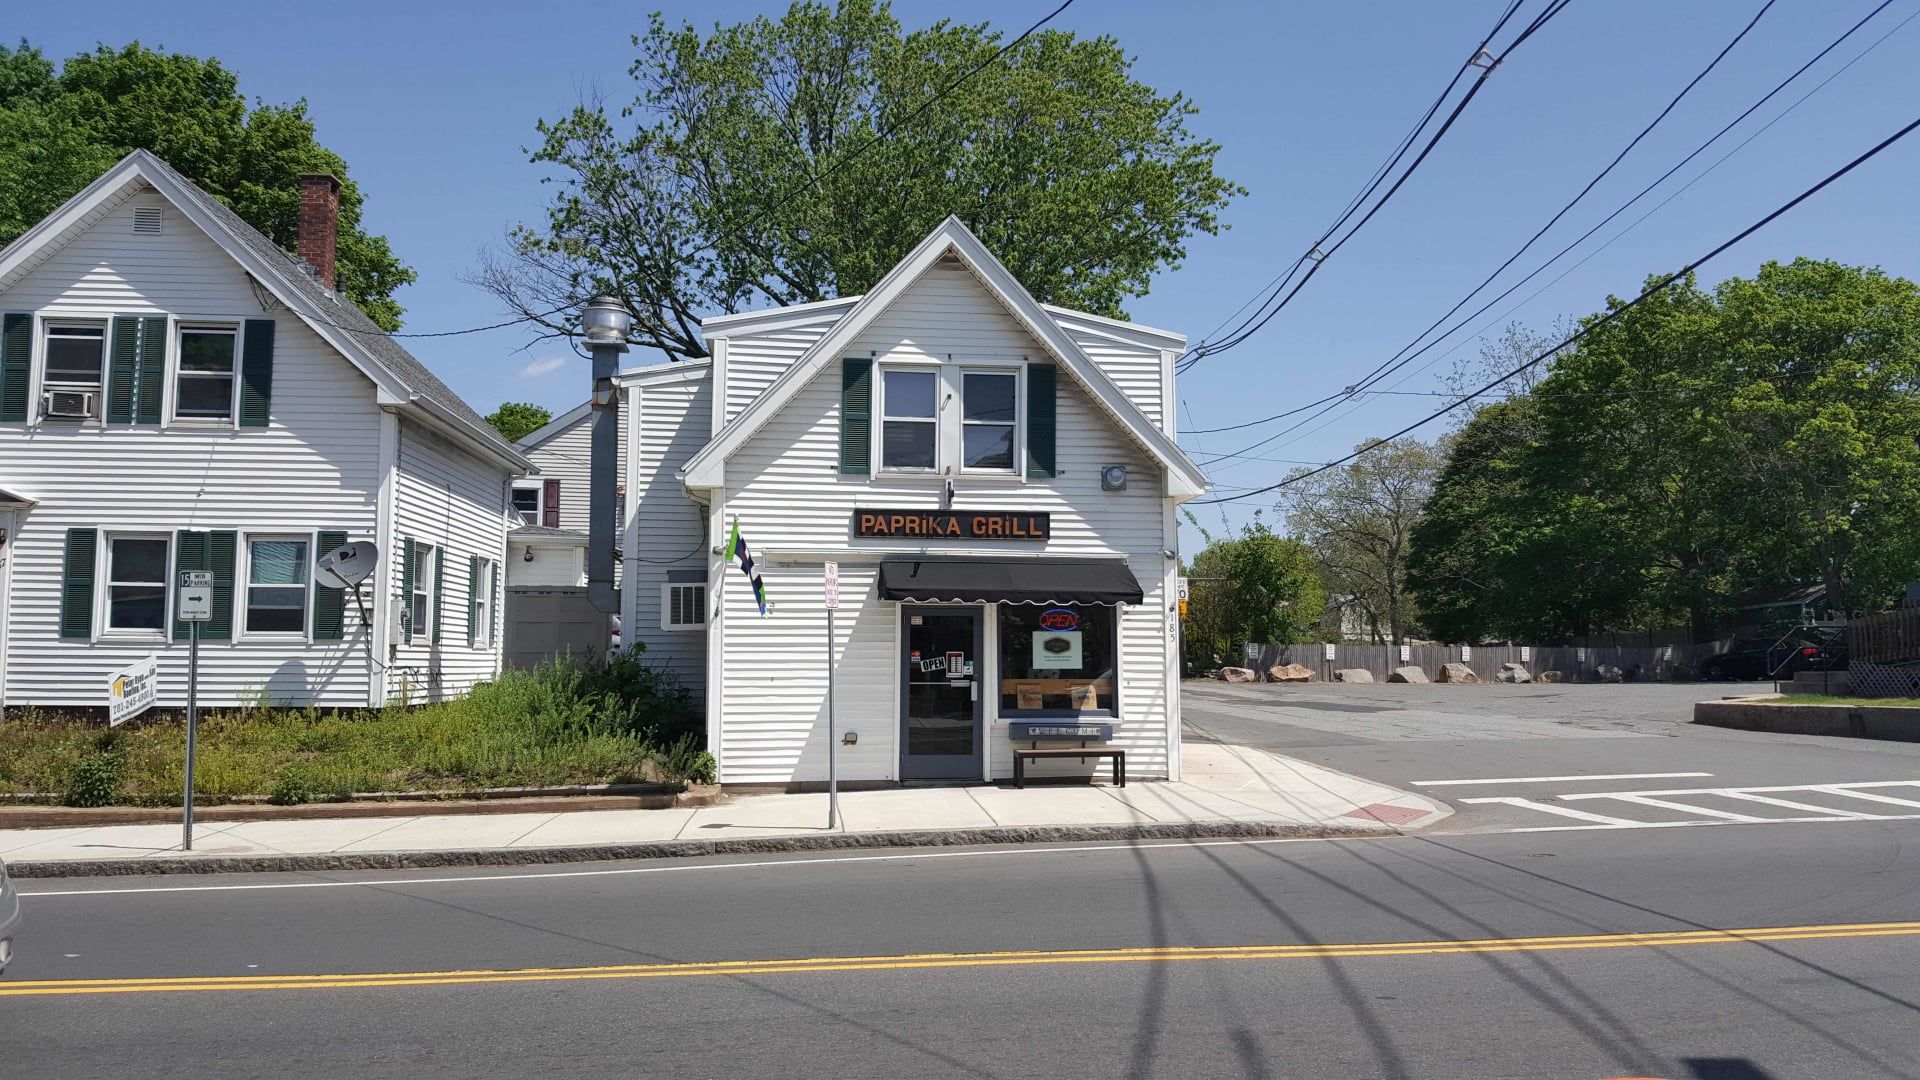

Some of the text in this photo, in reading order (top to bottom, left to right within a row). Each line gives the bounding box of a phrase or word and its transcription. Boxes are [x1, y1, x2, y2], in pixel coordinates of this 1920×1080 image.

[181, 573, 190, 587] 15
[1040, 614, 1078, 627] OPEN
[922, 658, 945, 671] OPEN
